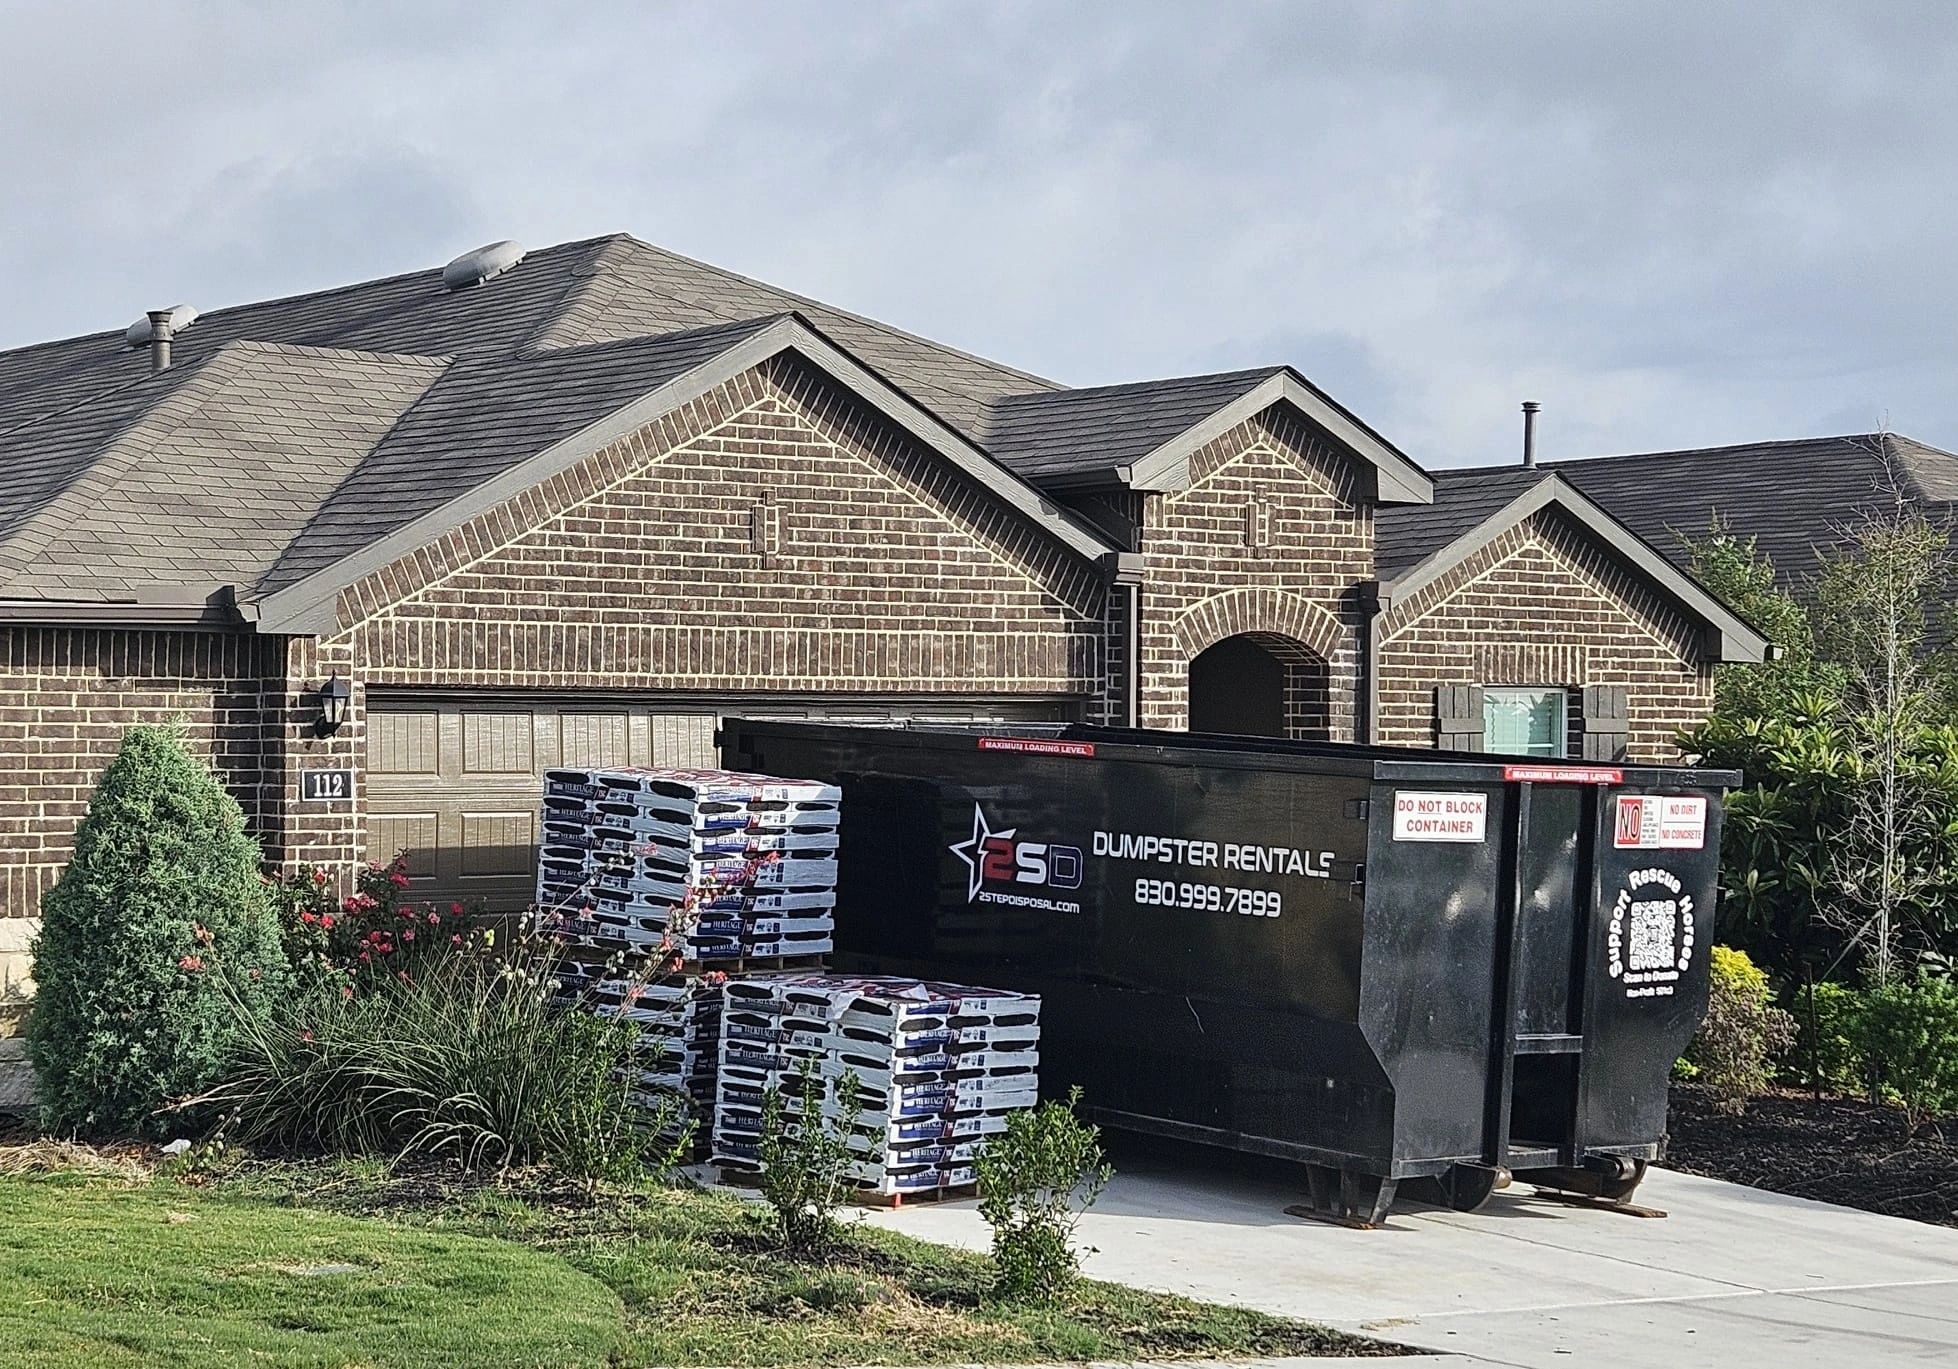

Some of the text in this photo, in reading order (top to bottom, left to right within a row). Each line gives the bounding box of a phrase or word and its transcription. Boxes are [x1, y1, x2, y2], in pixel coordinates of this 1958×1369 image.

[985, 741, 1087, 754] MAXIMUM LOADING LEVEL
[313, 774, 343, 797] 112
[1512, 770, 1615, 781] MAXIMUM LOADING LEVEL
[1398, 799, 1482, 814] DO NOT BLOCK
[1670, 804, 1679, 815] NO
[1406, 819, 1474, 833] CONTAINER
[1619, 803, 1641, 841] NO
[1093, 831, 1336, 878] DUMPSTER RENTALS
[1628, 868, 1682, 894] Rescue
[1135, 878, 1281, 918] 830.999.7899
[1678, 895, 1694, 971] Horses
